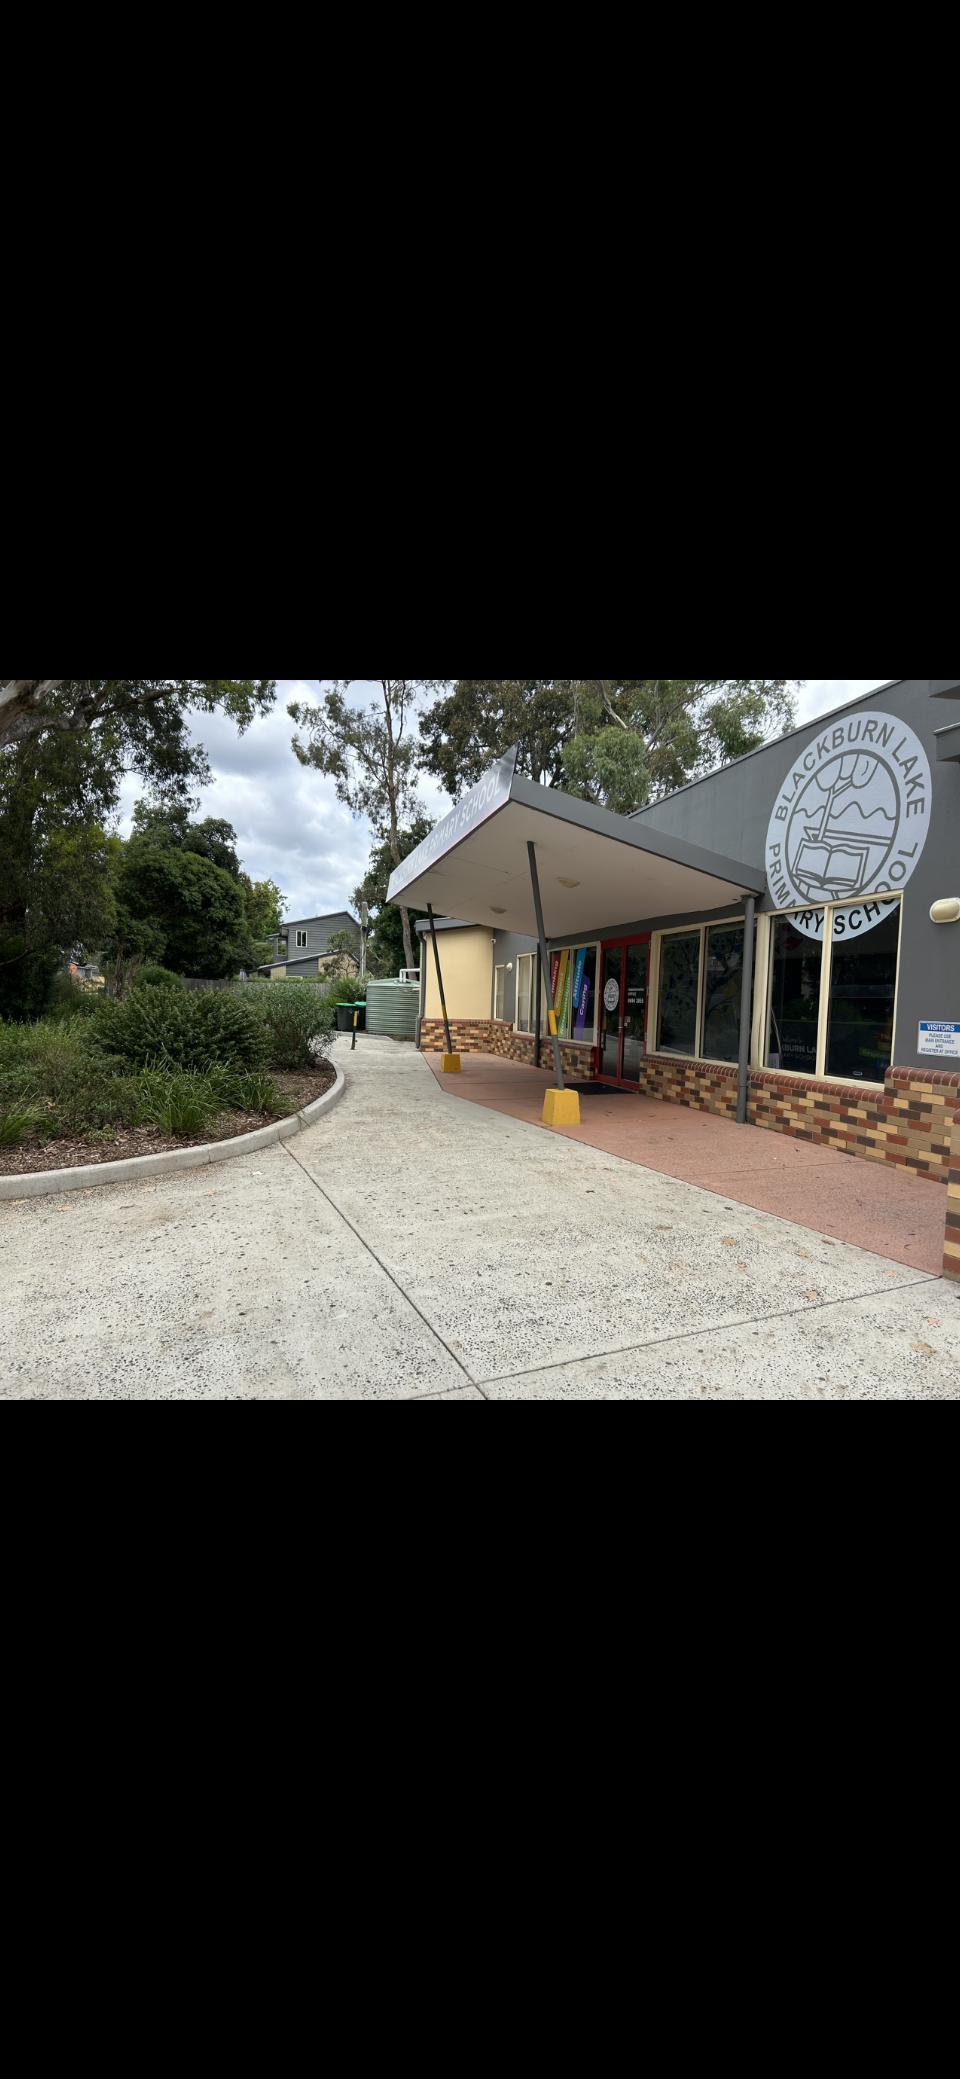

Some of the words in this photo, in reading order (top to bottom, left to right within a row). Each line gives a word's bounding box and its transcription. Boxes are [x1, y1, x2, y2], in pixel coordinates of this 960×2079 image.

[775, 720, 895, 821] BLACKBURN
[892, 737, 925, 818] LAKE
[428, 811, 461, 857] PRIMARY
[460, 771, 501, 827] SCHOOL
[769, 843, 825, 933] PRIMARY
[834, 843, 918, 935] SCHOOL
[551, 960, 559, 997] hinking
[560, 974, 571, 1034] Responsibilit
[573, 960, 582, 999] Attitude
[926, 1023, 955, 1032] VISITORS
